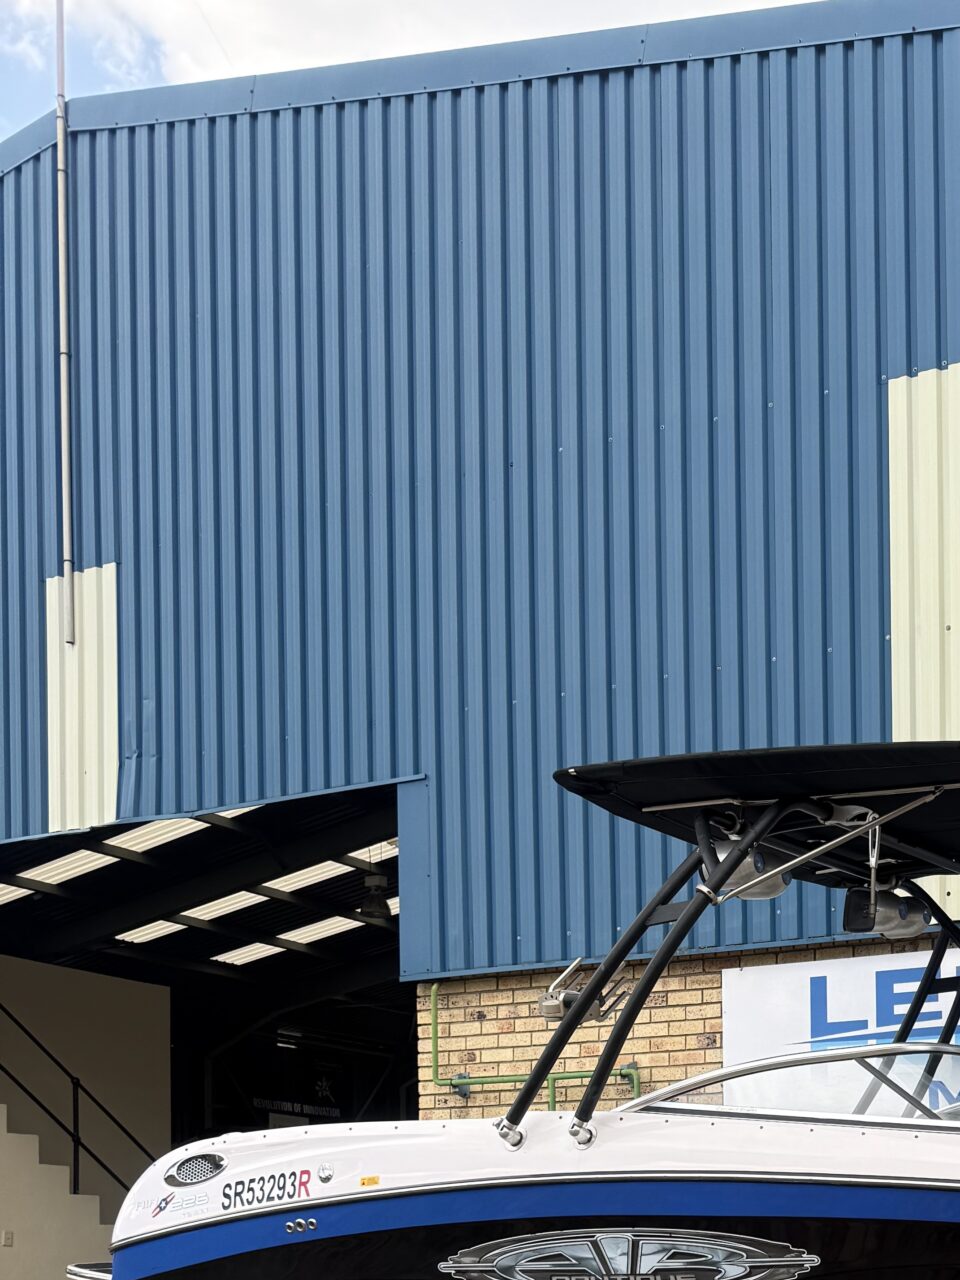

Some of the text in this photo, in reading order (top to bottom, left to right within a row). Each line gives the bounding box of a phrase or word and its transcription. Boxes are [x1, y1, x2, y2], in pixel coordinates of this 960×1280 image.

[253, 1097, 341, 1118] REVOLUTION OF INNOVATION
[222, 1170, 311, 1210] SR53293R
